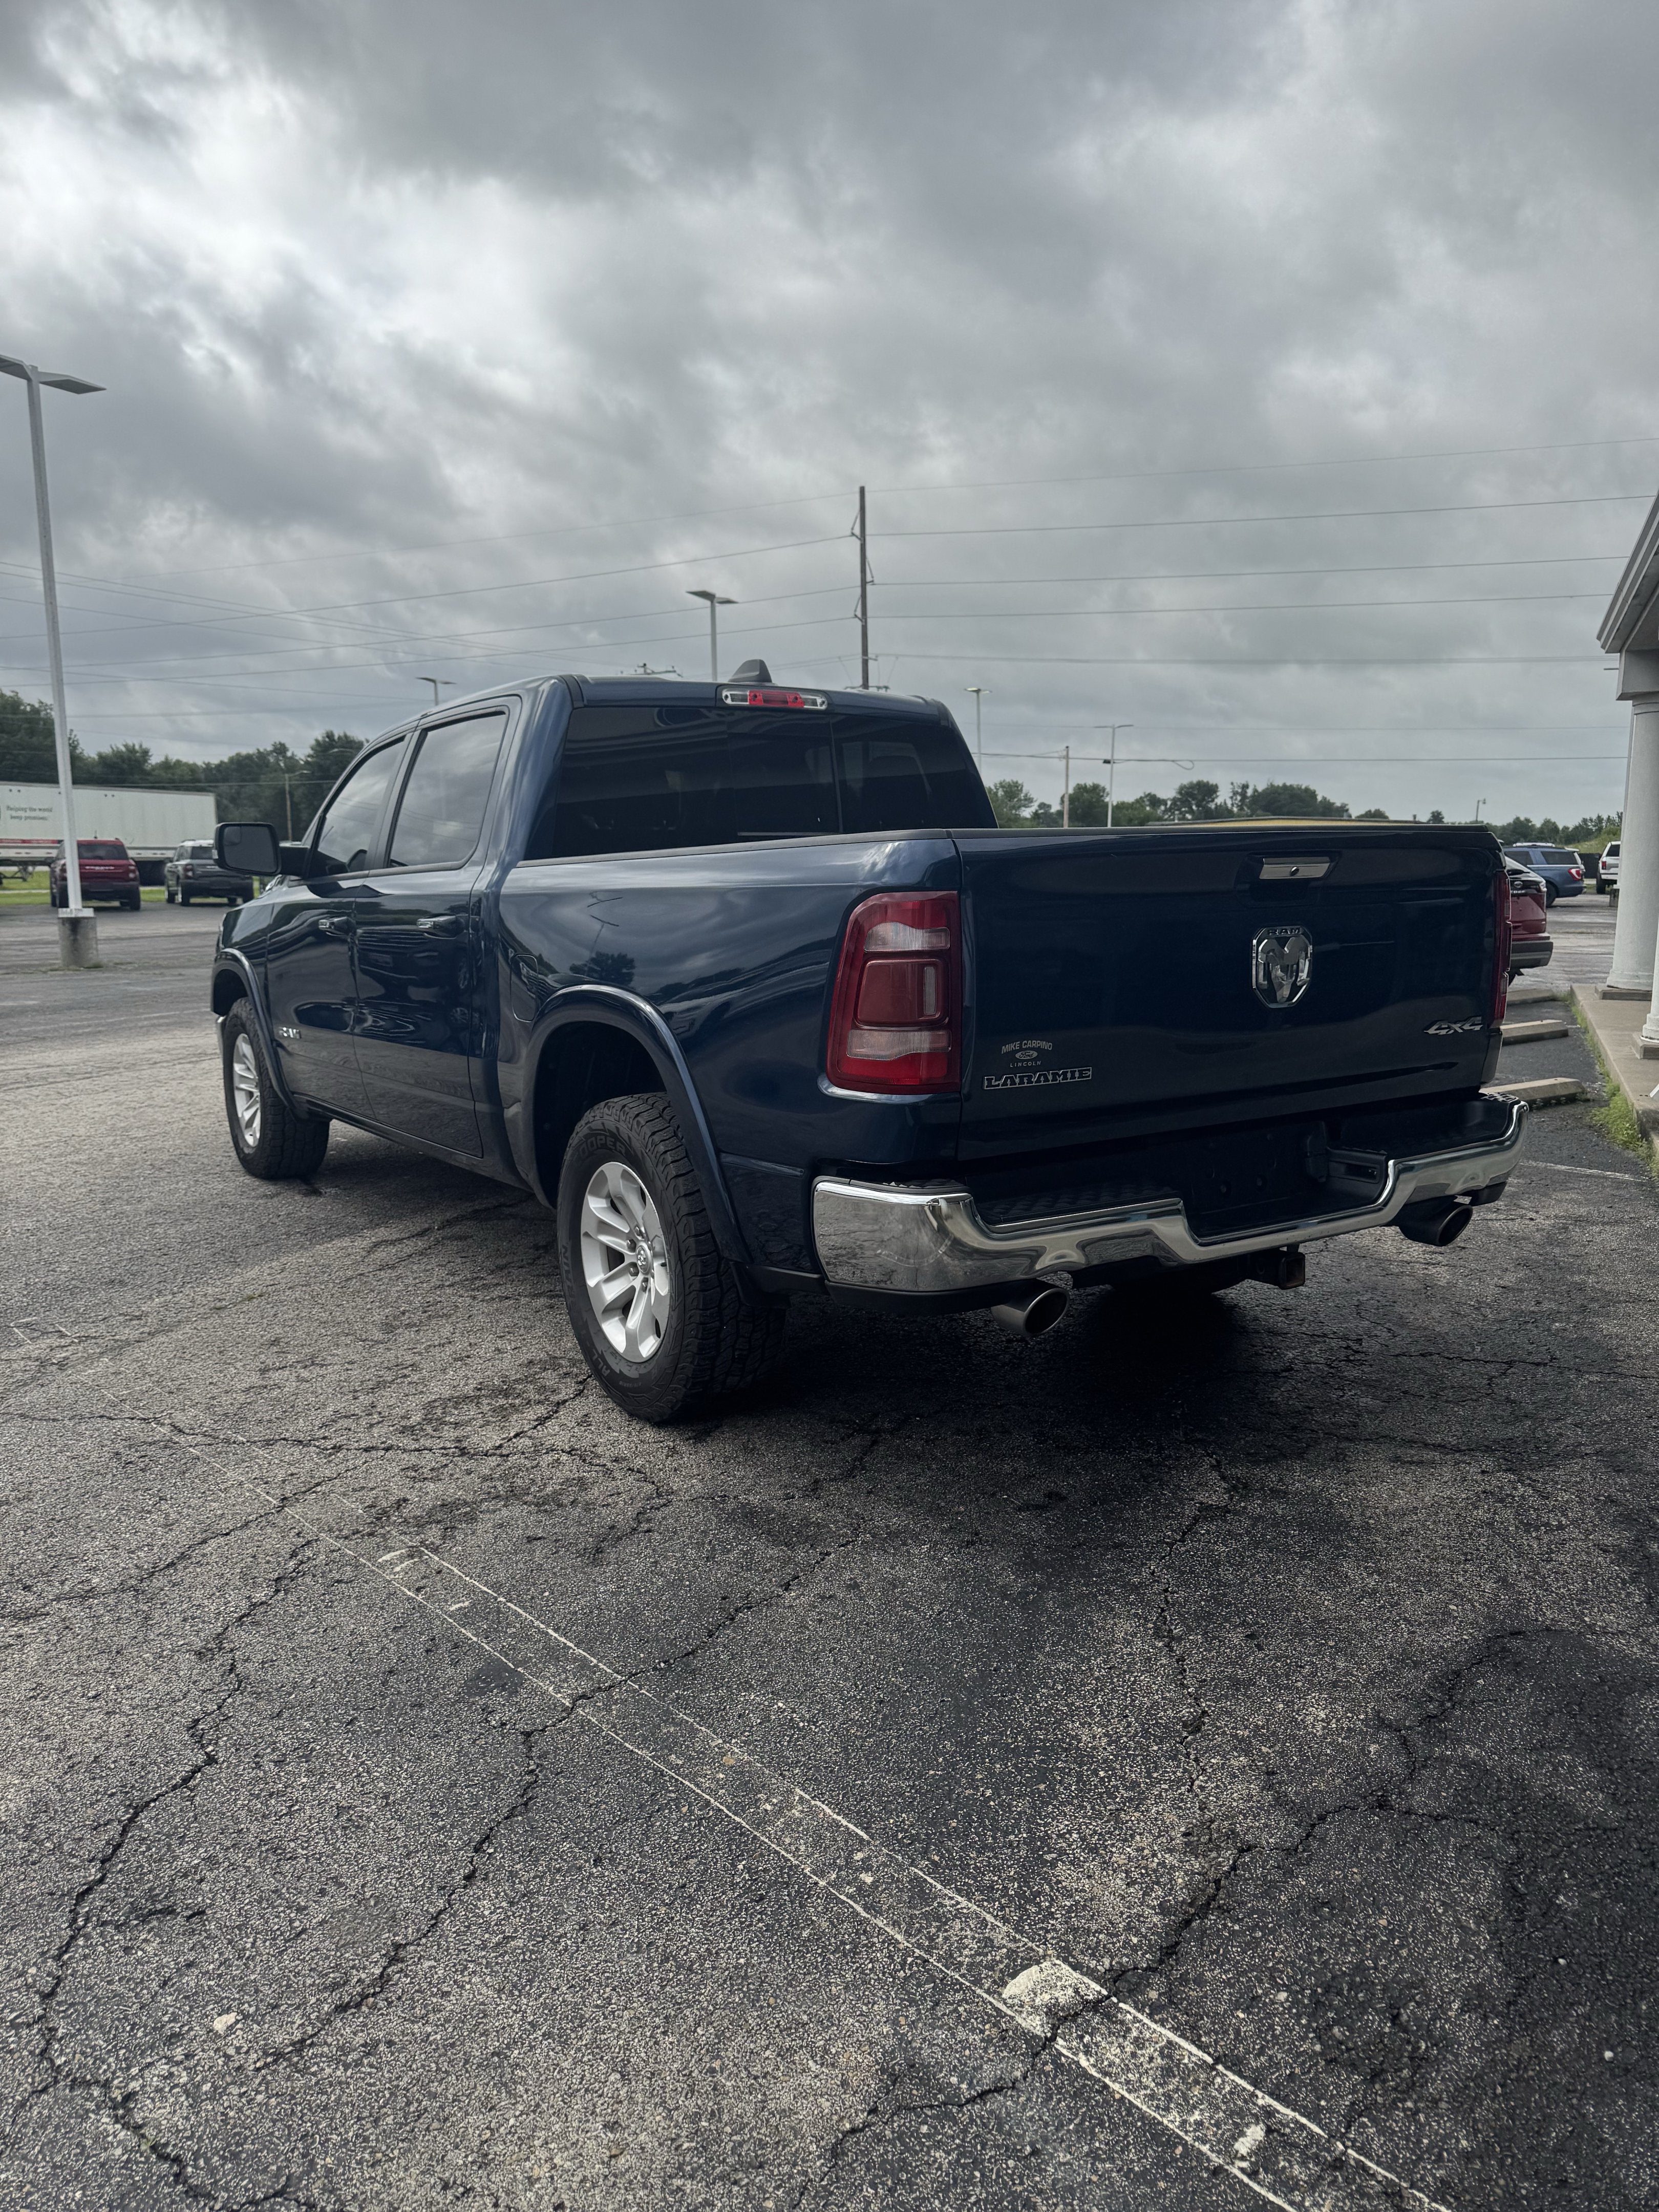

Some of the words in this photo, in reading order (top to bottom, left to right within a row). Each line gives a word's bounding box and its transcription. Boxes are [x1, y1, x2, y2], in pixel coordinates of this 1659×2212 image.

[1268, 927, 1302, 935] RAM
[1002, 1041, 1020, 1054] MIKE
[1022, 1040, 1052, 1050] CARPINO
[984, 1067, 1092, 1090] LARAMIE
